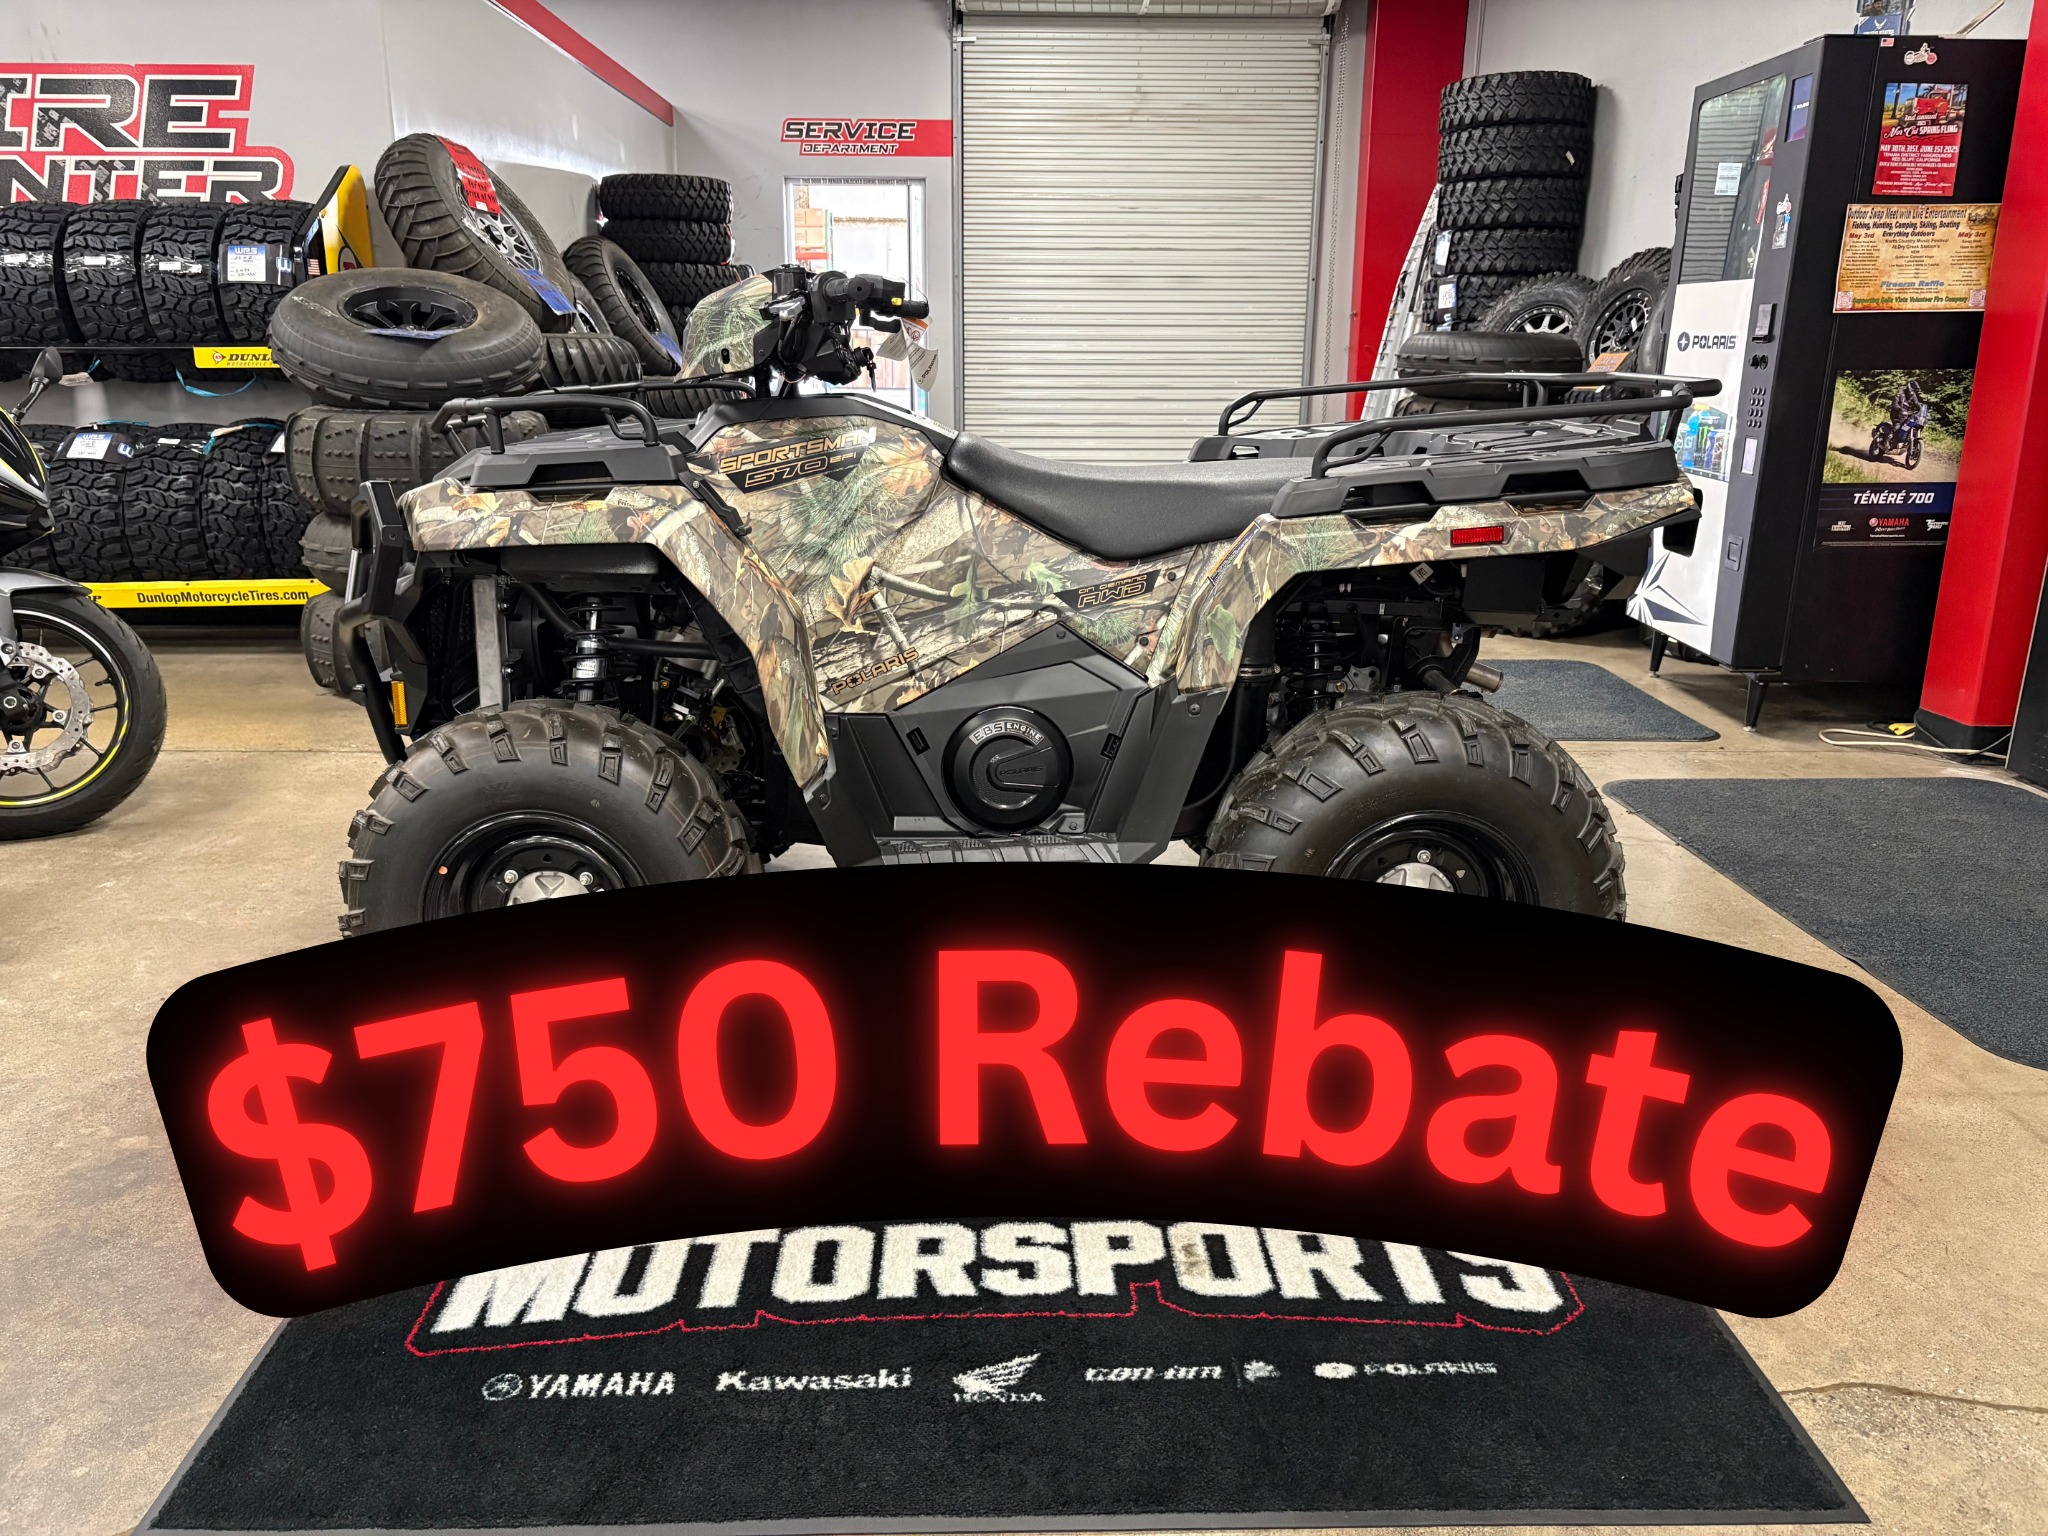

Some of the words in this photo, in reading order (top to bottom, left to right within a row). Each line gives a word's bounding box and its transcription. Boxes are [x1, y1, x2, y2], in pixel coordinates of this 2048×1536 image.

[783, 121, 917, 141] SERVICE
[1919, 125, 1941, 135] SPRING
[1940, 124, 1959, 134] FLING
[802, 143, 900, 155] DEPARTMENT
[1880, 144, 1891, 152] MAY
[1943, 145, 1959, 153] 2025
[1848, 207, 1869, 219] Outdoor
[1869, 207, 1885, 222] Swap
[1885, 207, 1899, 220] Meet
[1899, 208, 1912, 220] with
[1912, 208, 1924, 219] Live
[1925, 207, 1967, 219] Entertainment
[1852, 221, 1871, 230] Fishing,
[1872, 221, 1893, 230] Hunting,
[1895, 221, 1918, 230] Camping,
[1919, 221, 1938, 230] Skiing,
[1939, 220, 1961, 229] Boating
[234, 247, 259, 255] WPS
[1692, 335, 1737, 350] POLARIS
[719, 426, 877, 473] SPORTSMAN
[744, 455, 829, 488] 570
[829, 452, 857, 464] EFI
[1853, 490, 1907, 505] TÉNÉRÉ
[1907, 492, 1935, 504] 700
[1879, 518, 1910, 526] YAMAHA
[1078, 586, 1095, 595] ON
[1099, 574, 1147, 590] DEMAND
[137, 590, 309, 605] DunlopMotorcycleTires.com
[1077, 581, 1147, 609] AWD
[831, 647, 919, 696] POLARIS
[973, 722, 1003, 742] EBS
[1006, 722, 1042, 741] ENGINE
[1000, 766, 1043, 776] POLARIS
[430, 1221, 1563, 1333] MOTORSPORTS
[528, 1371, 677, 1399] YAMAHA
[715, 1366, 912, 1392] Kawasaki
